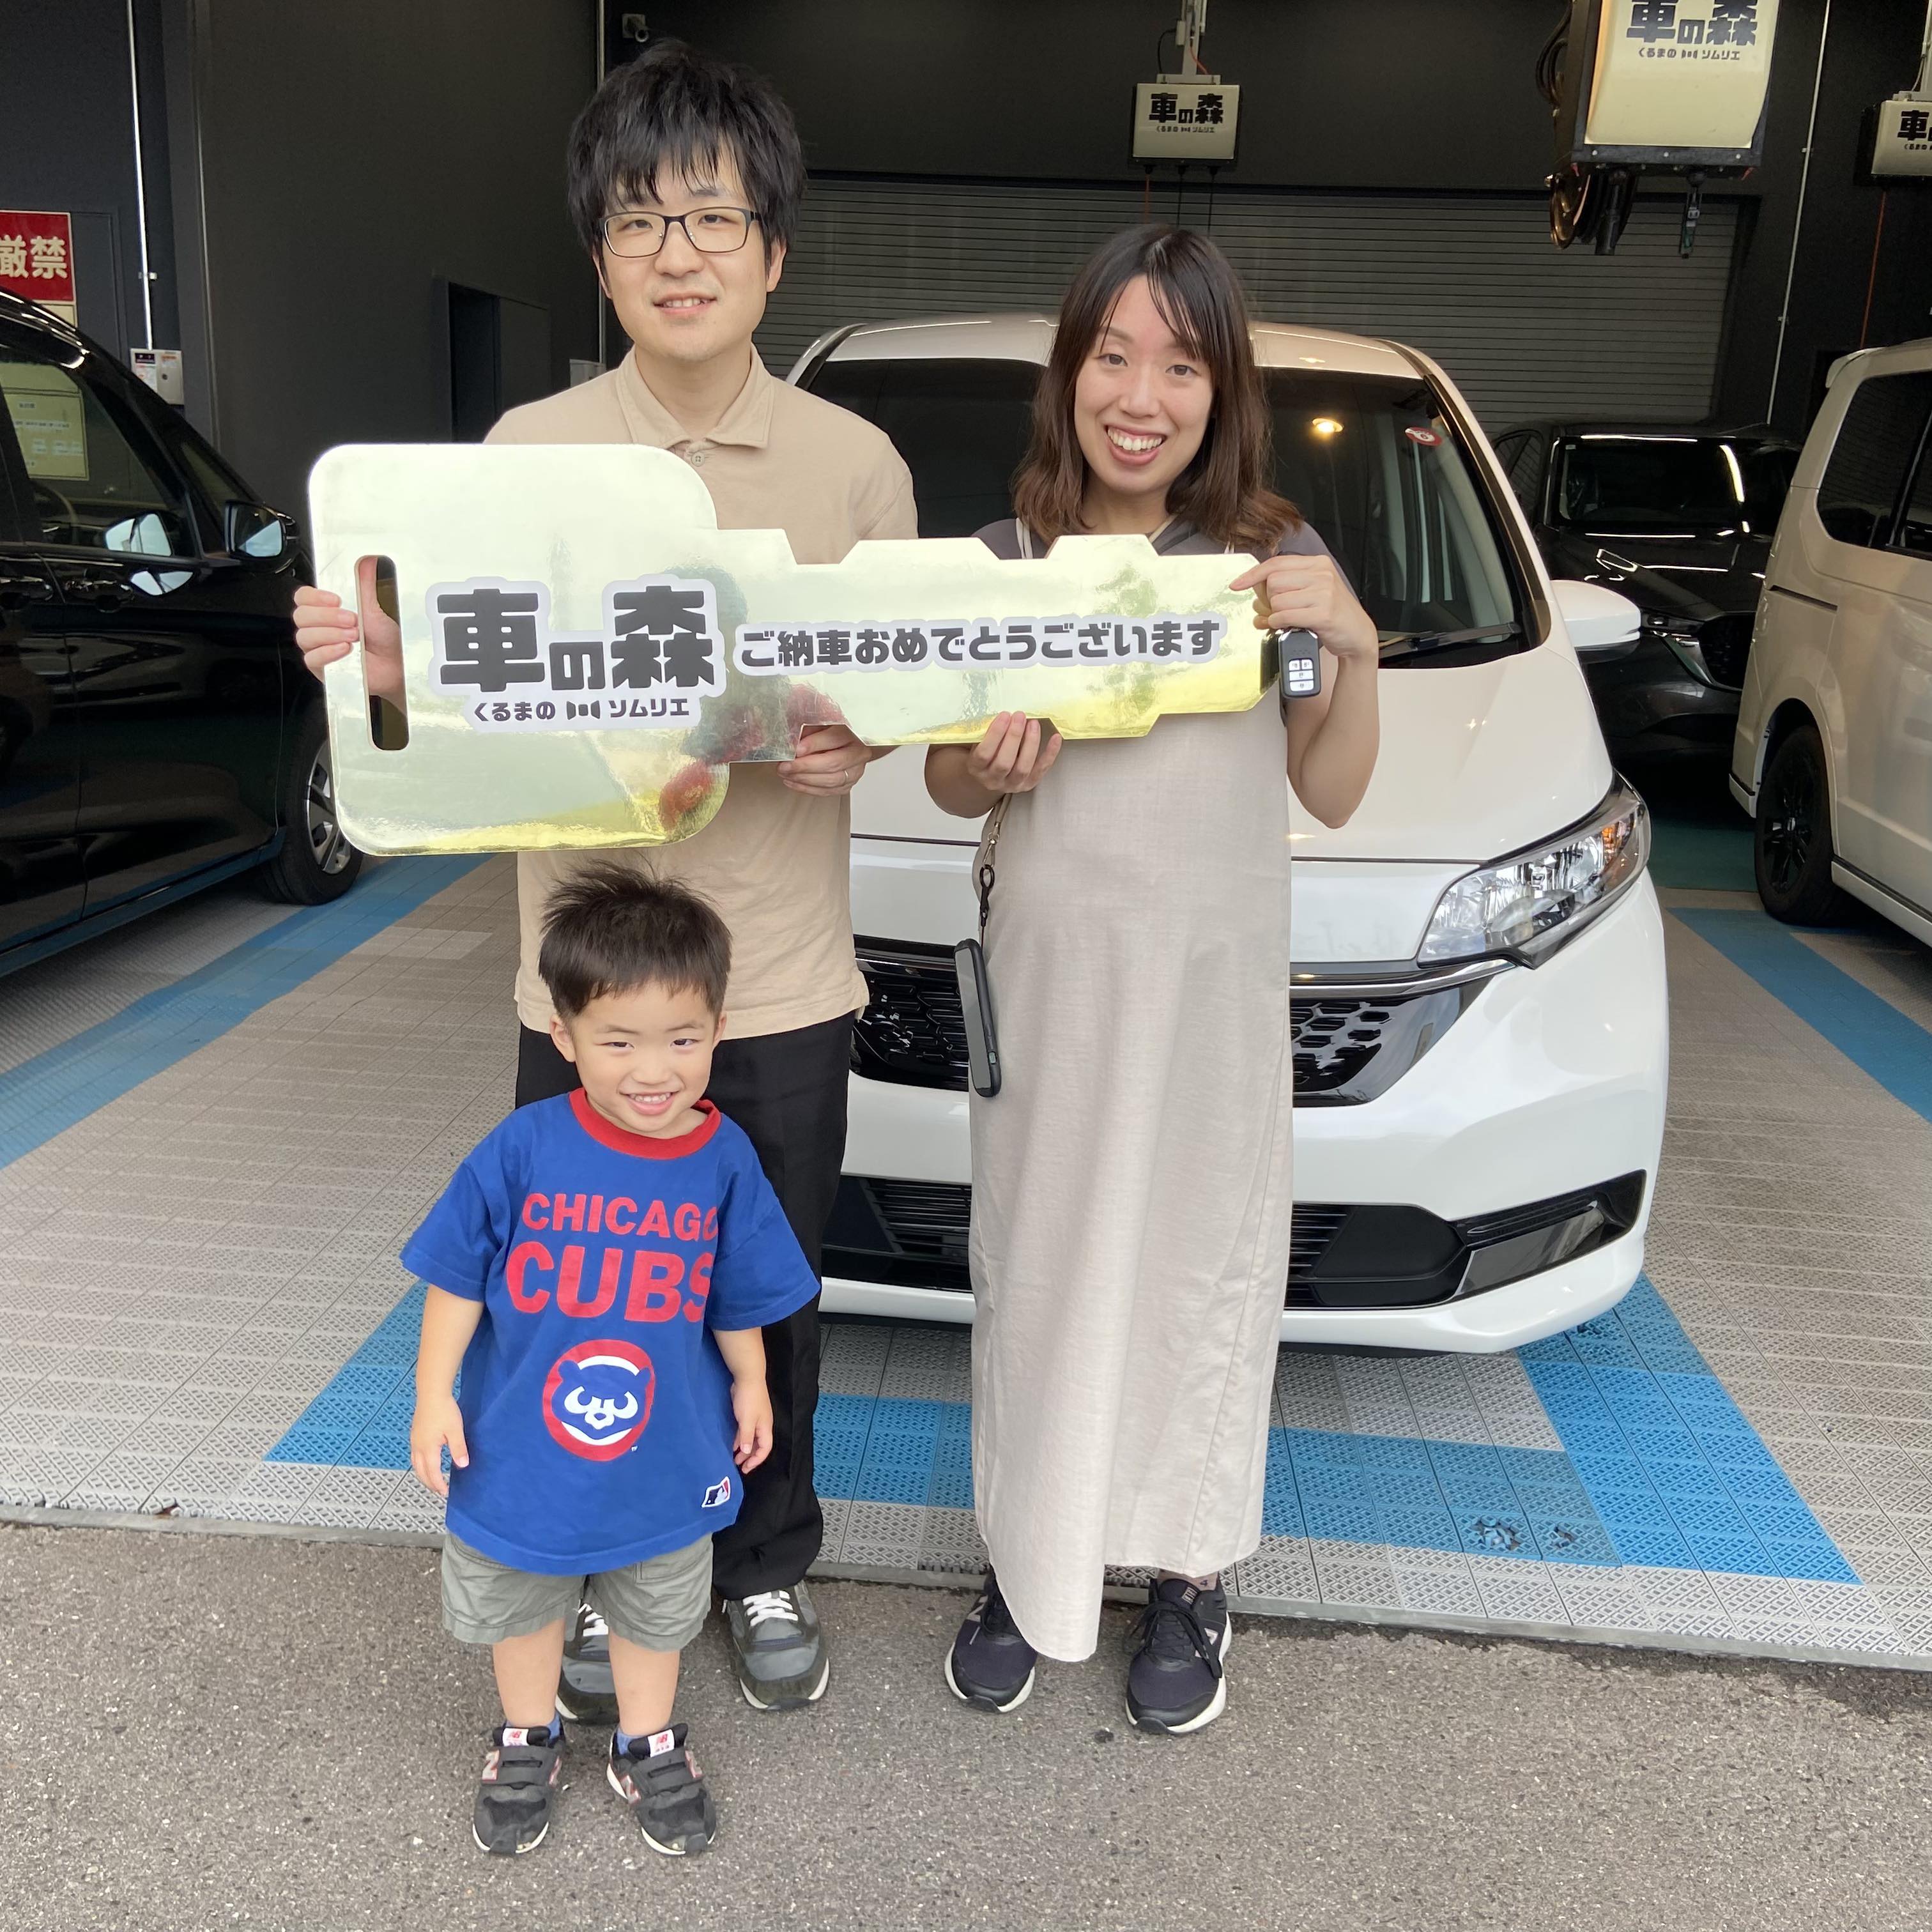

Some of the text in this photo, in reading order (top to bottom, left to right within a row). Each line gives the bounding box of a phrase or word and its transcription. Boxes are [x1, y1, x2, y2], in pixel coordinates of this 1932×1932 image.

[1627, 0, 1758, 46] 車の森
[1639, 48, 1740, 61] くるまの ソムリエ
[1149, 93, 1223, 124] 車の森
[437, 585, 715, 693] 車の森
[741, 619, 1220, 667] ご納車おめでとうございます
[474, 697, 690, 721] くるまの ソムリエ
[505, 1241, 716, 1323] CUBS
